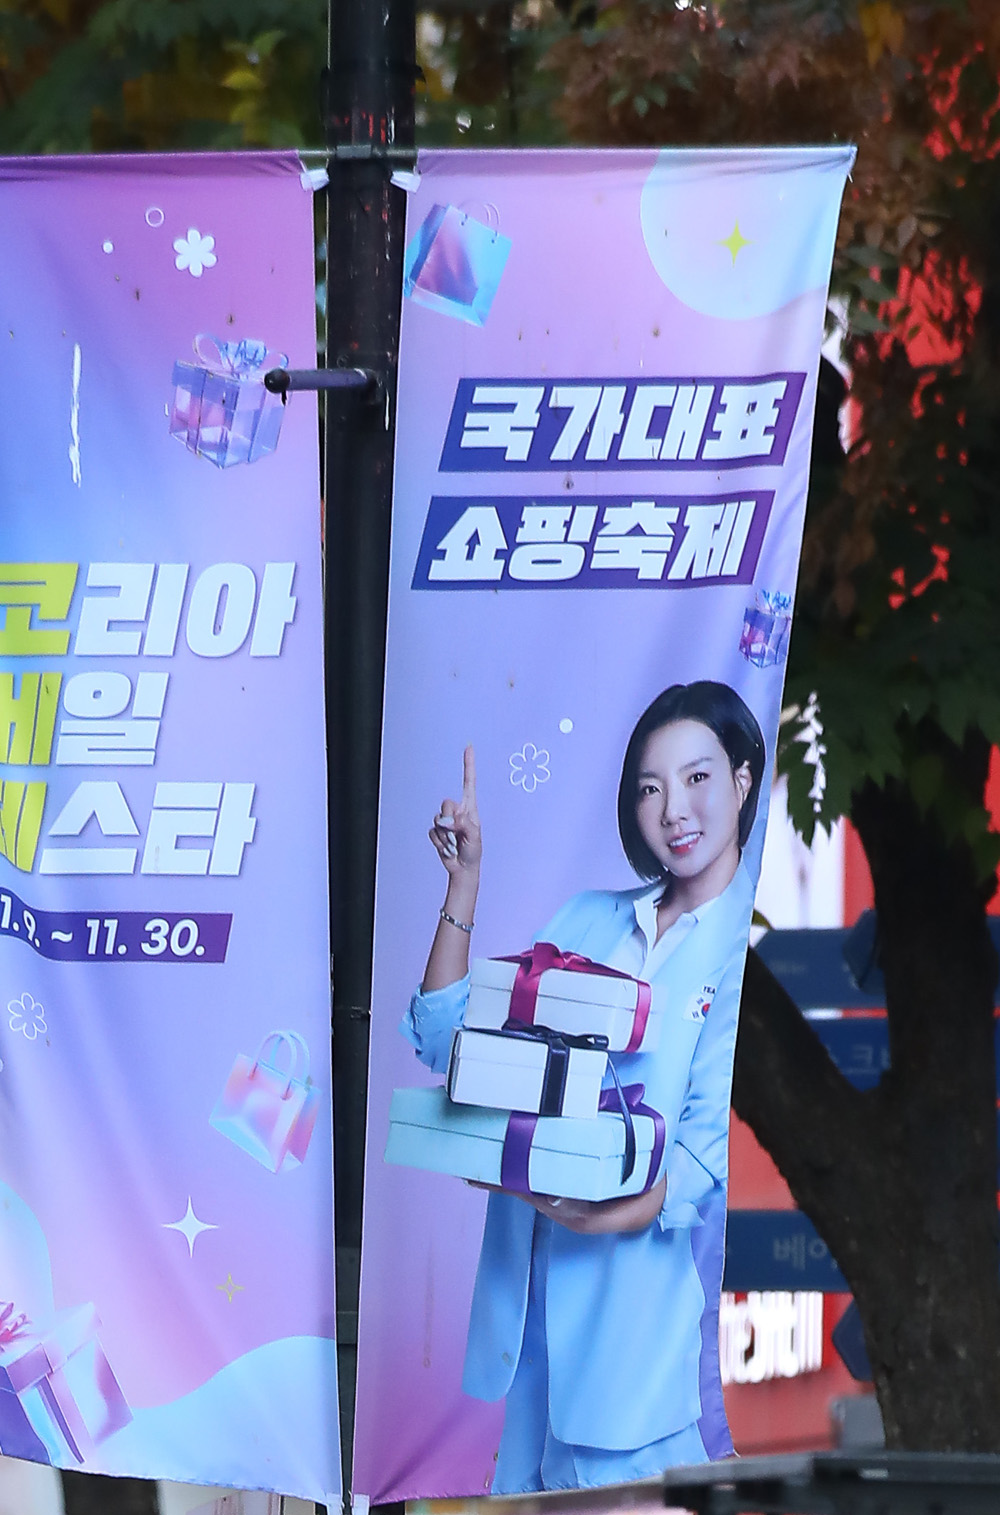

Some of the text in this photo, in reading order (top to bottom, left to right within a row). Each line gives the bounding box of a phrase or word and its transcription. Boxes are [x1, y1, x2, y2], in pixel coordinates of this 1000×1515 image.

[459, 379, 787, 463] 국가대표
[427, 500, 757, 583] 쇼핑축제
[84, 919, 128, 957] 11.
[140, 919, 206, 957] 30.
